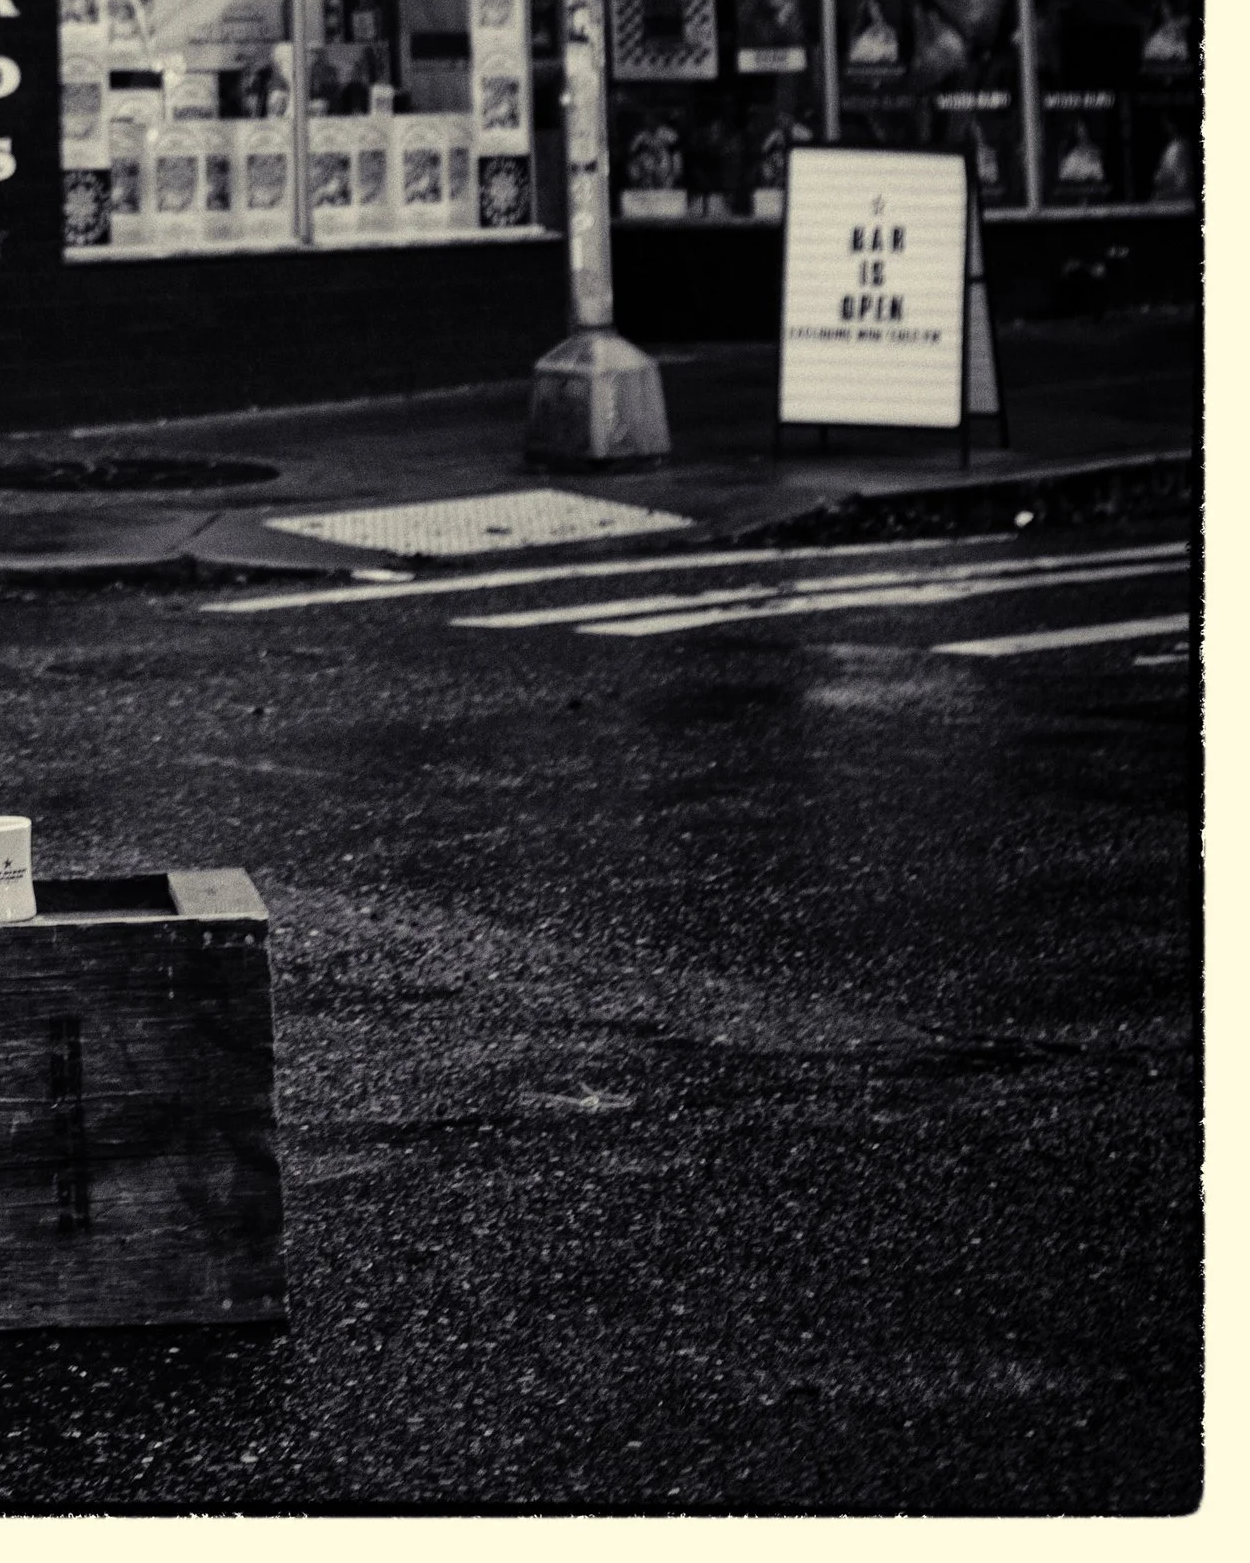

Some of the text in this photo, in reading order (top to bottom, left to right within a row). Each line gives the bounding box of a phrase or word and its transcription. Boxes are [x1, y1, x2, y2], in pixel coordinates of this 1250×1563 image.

[851, 225, 906, 253] BAR
[861, 259, 886, 287] IS
[840, 293, 905, 321] OPEN
